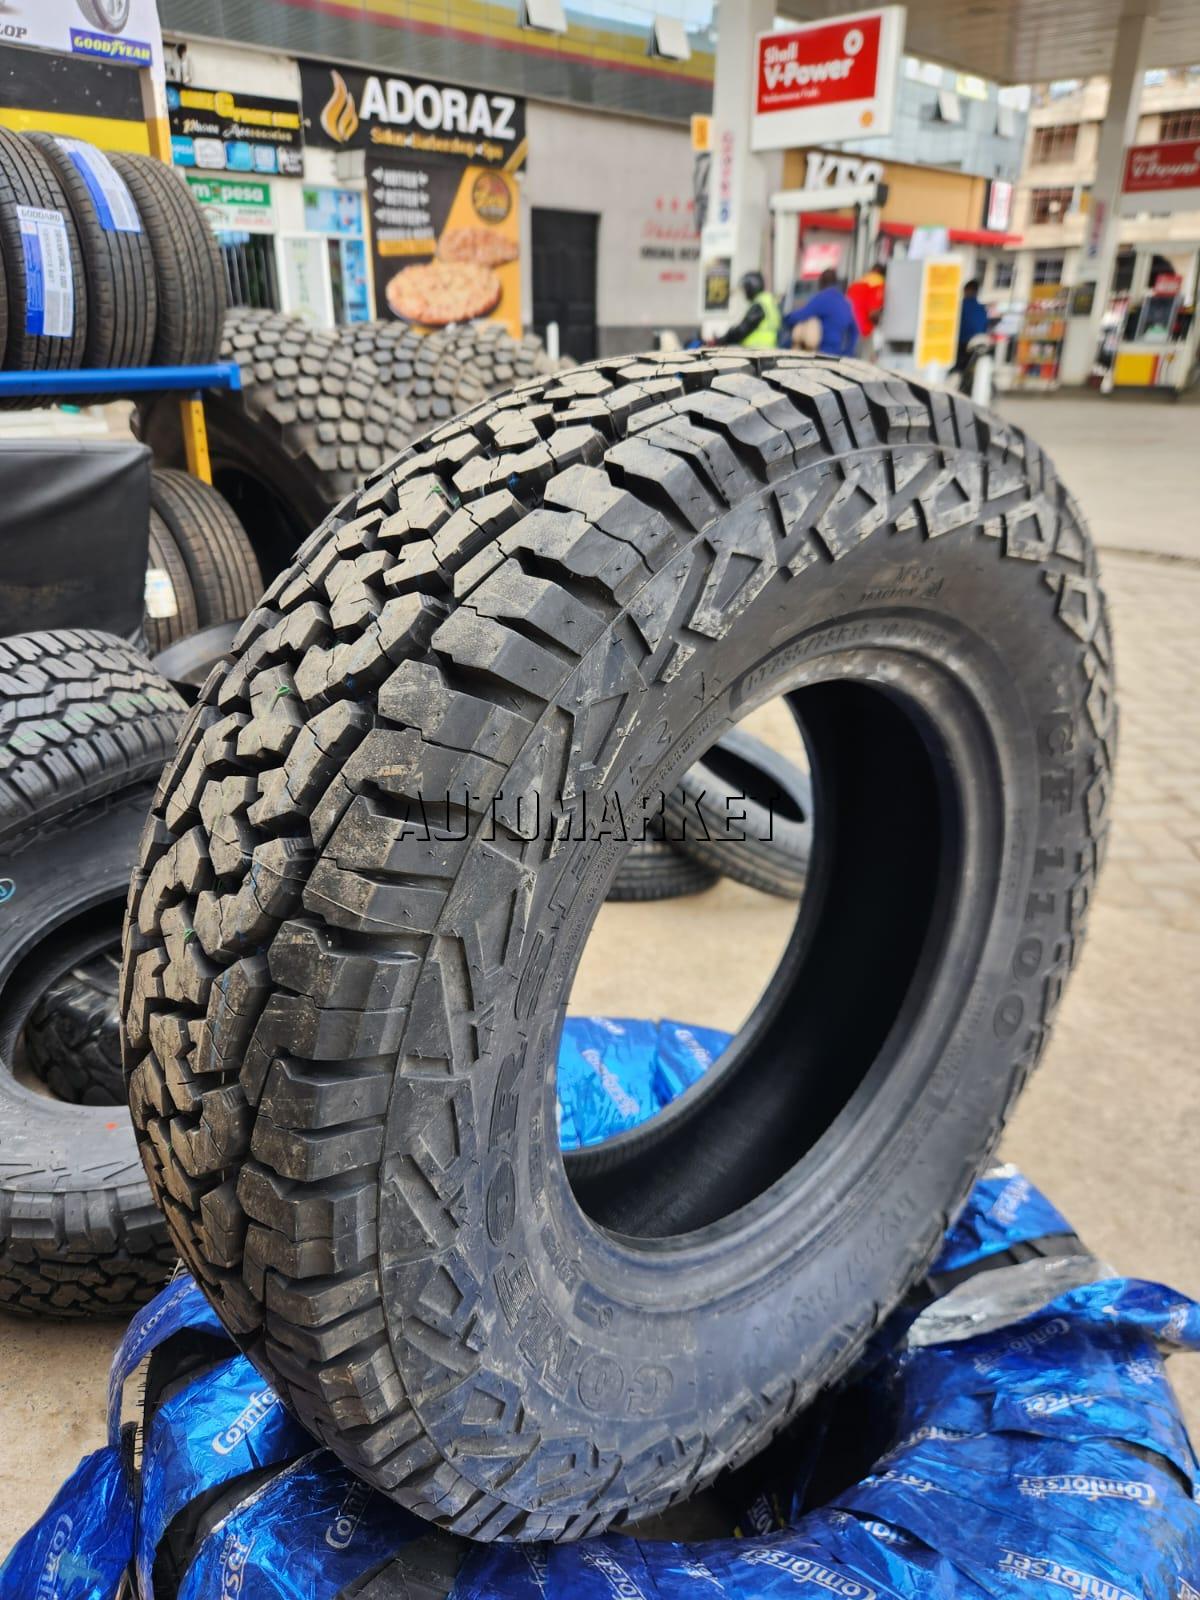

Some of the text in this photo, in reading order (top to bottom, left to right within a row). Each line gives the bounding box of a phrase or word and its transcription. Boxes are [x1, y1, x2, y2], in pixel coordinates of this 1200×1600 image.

[73, 35, 150, 59] GOODYEAR
[764, 41, 798, 65] Shell
[764, 58, 854, 90] V-Power
[359, 76, 516, 140] ADORAZ
[993, 709, 1074, 1041] CF1100
[1020, 1476, 1157, 1505] Comforser
